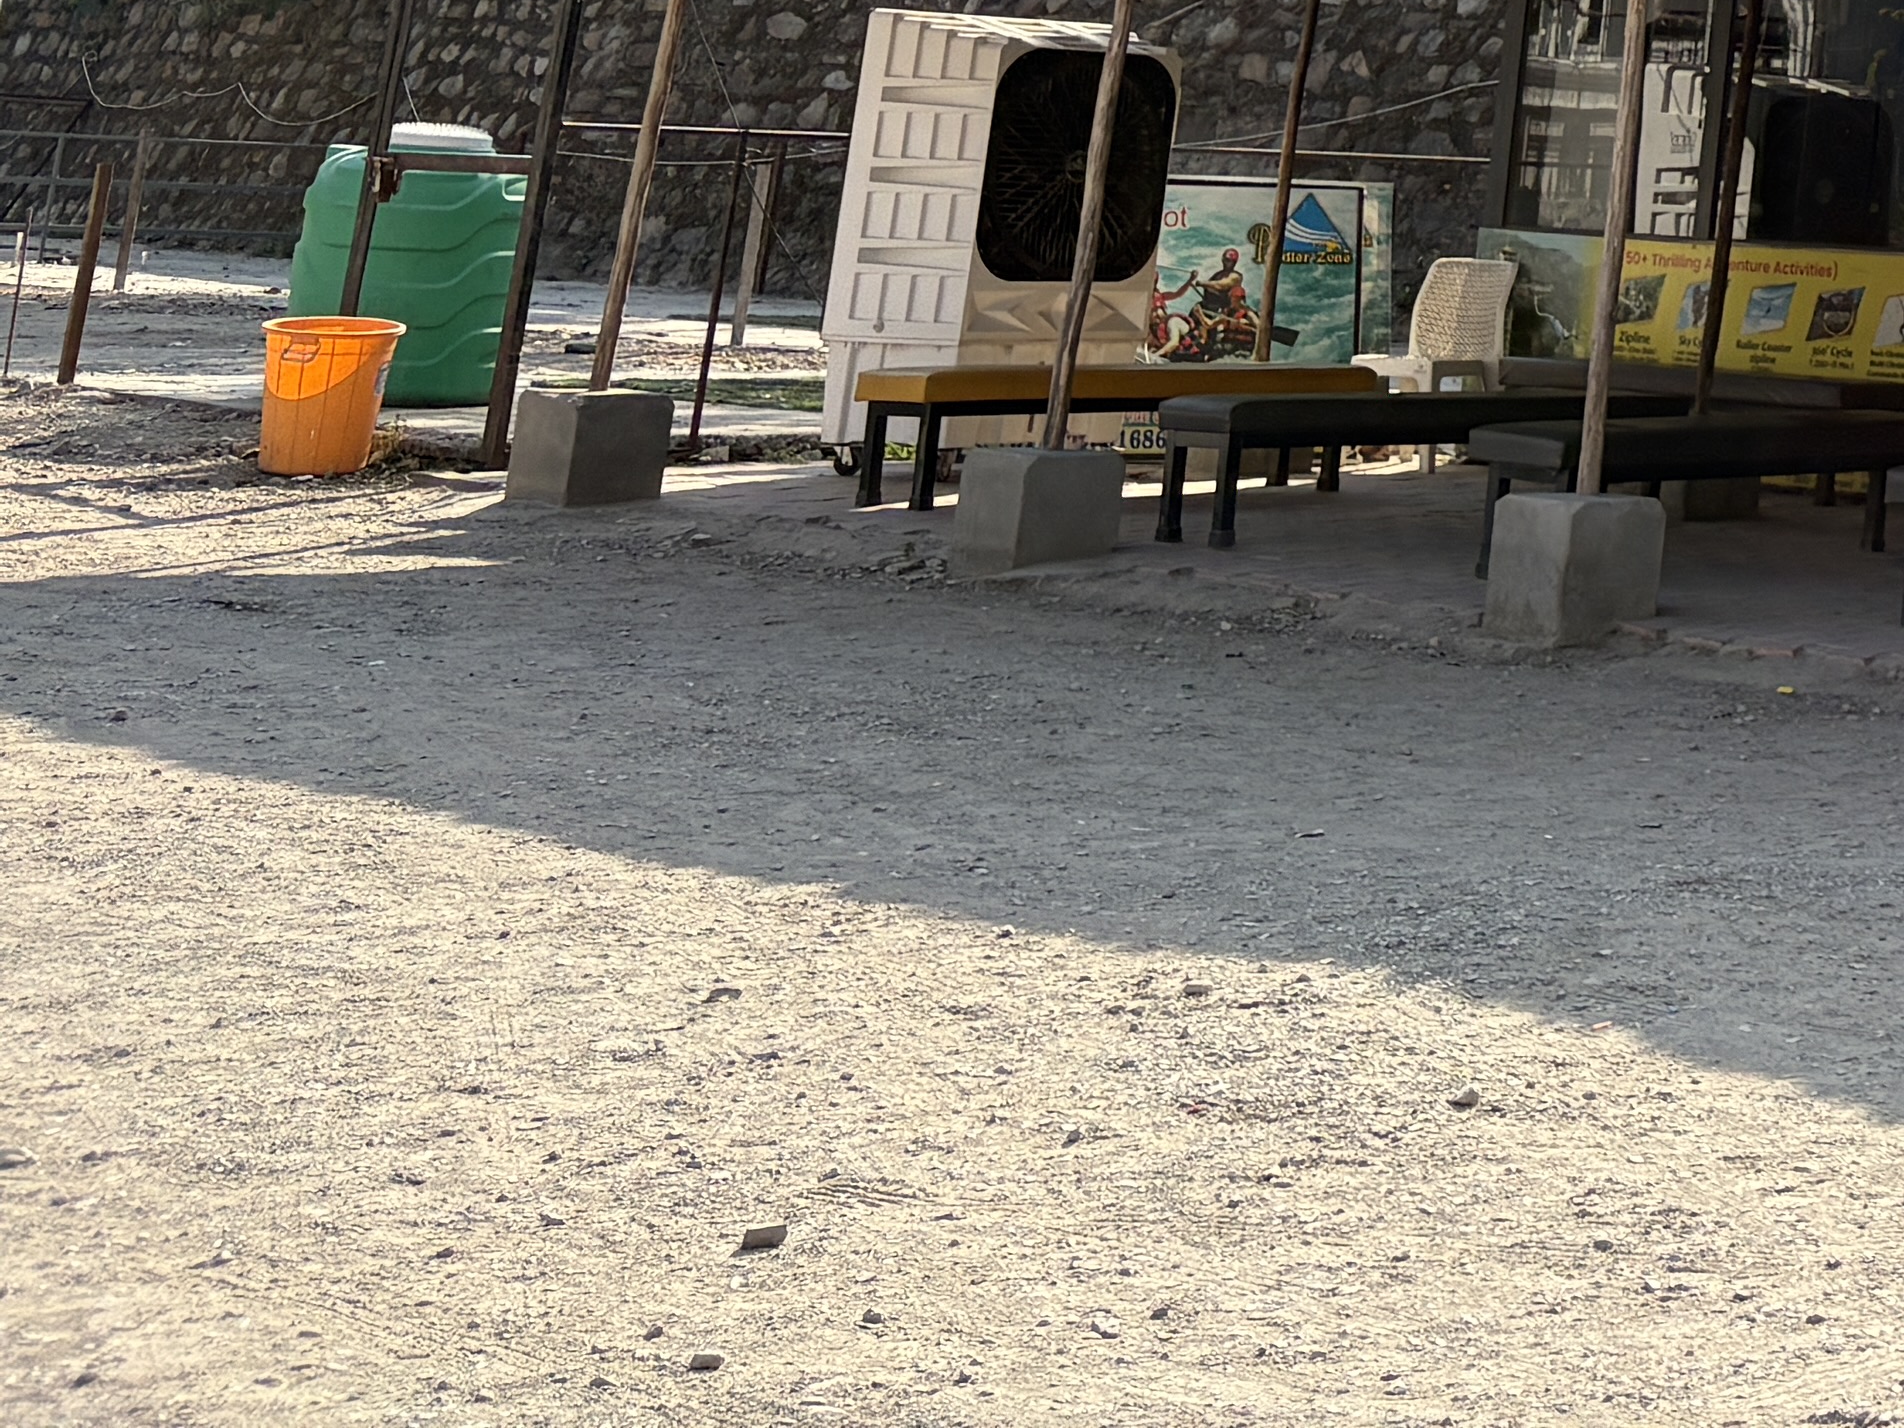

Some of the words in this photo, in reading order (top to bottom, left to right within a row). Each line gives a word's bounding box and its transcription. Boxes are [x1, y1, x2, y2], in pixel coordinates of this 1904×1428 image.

[1626, 253, 1647, 265] 50+
[1652, 254, 1701, 273] Thrilling
[1704, 259, 1771, 274] Aenture
[1773, 260, 1838, 281] Activities)
